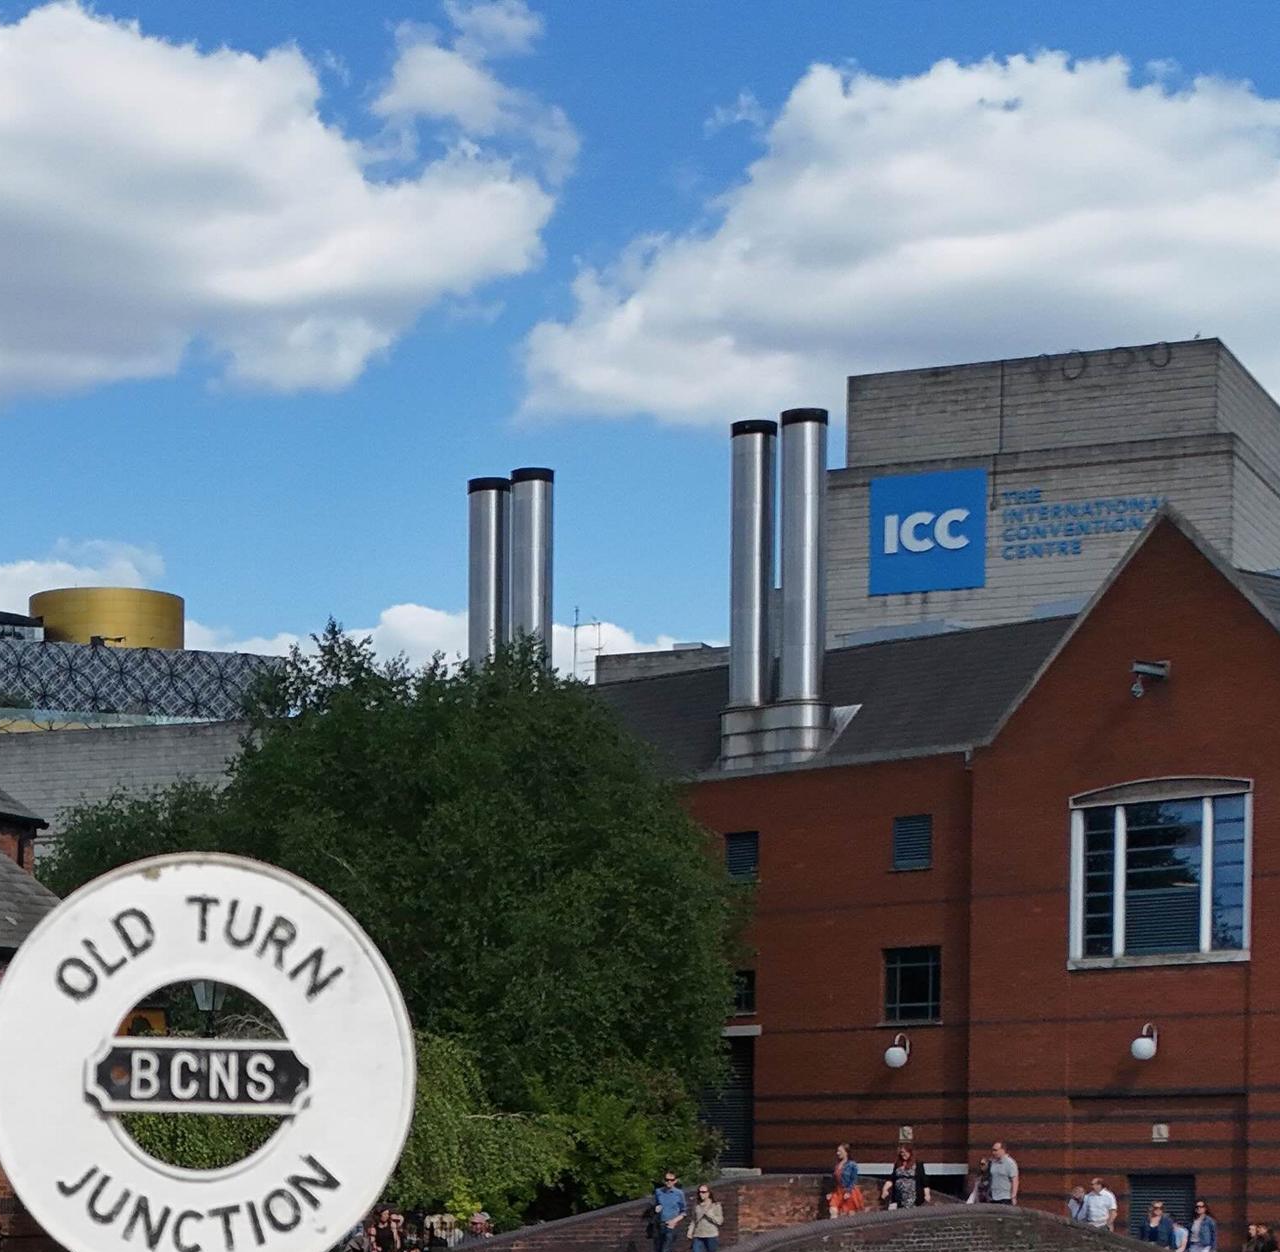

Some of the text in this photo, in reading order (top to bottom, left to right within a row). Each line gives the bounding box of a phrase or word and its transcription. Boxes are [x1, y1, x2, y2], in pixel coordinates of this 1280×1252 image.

[1003, 488, 1041, 505] THE
[884, 508, 970, 554] ICC
[1002, 515, 1144, 543] CONVENTION
[1002, 539, 1081, 561] CENTRE
[55, 894, 344, 1002] OLD TURN
[129, 1050, 277, 1101] BCNS
